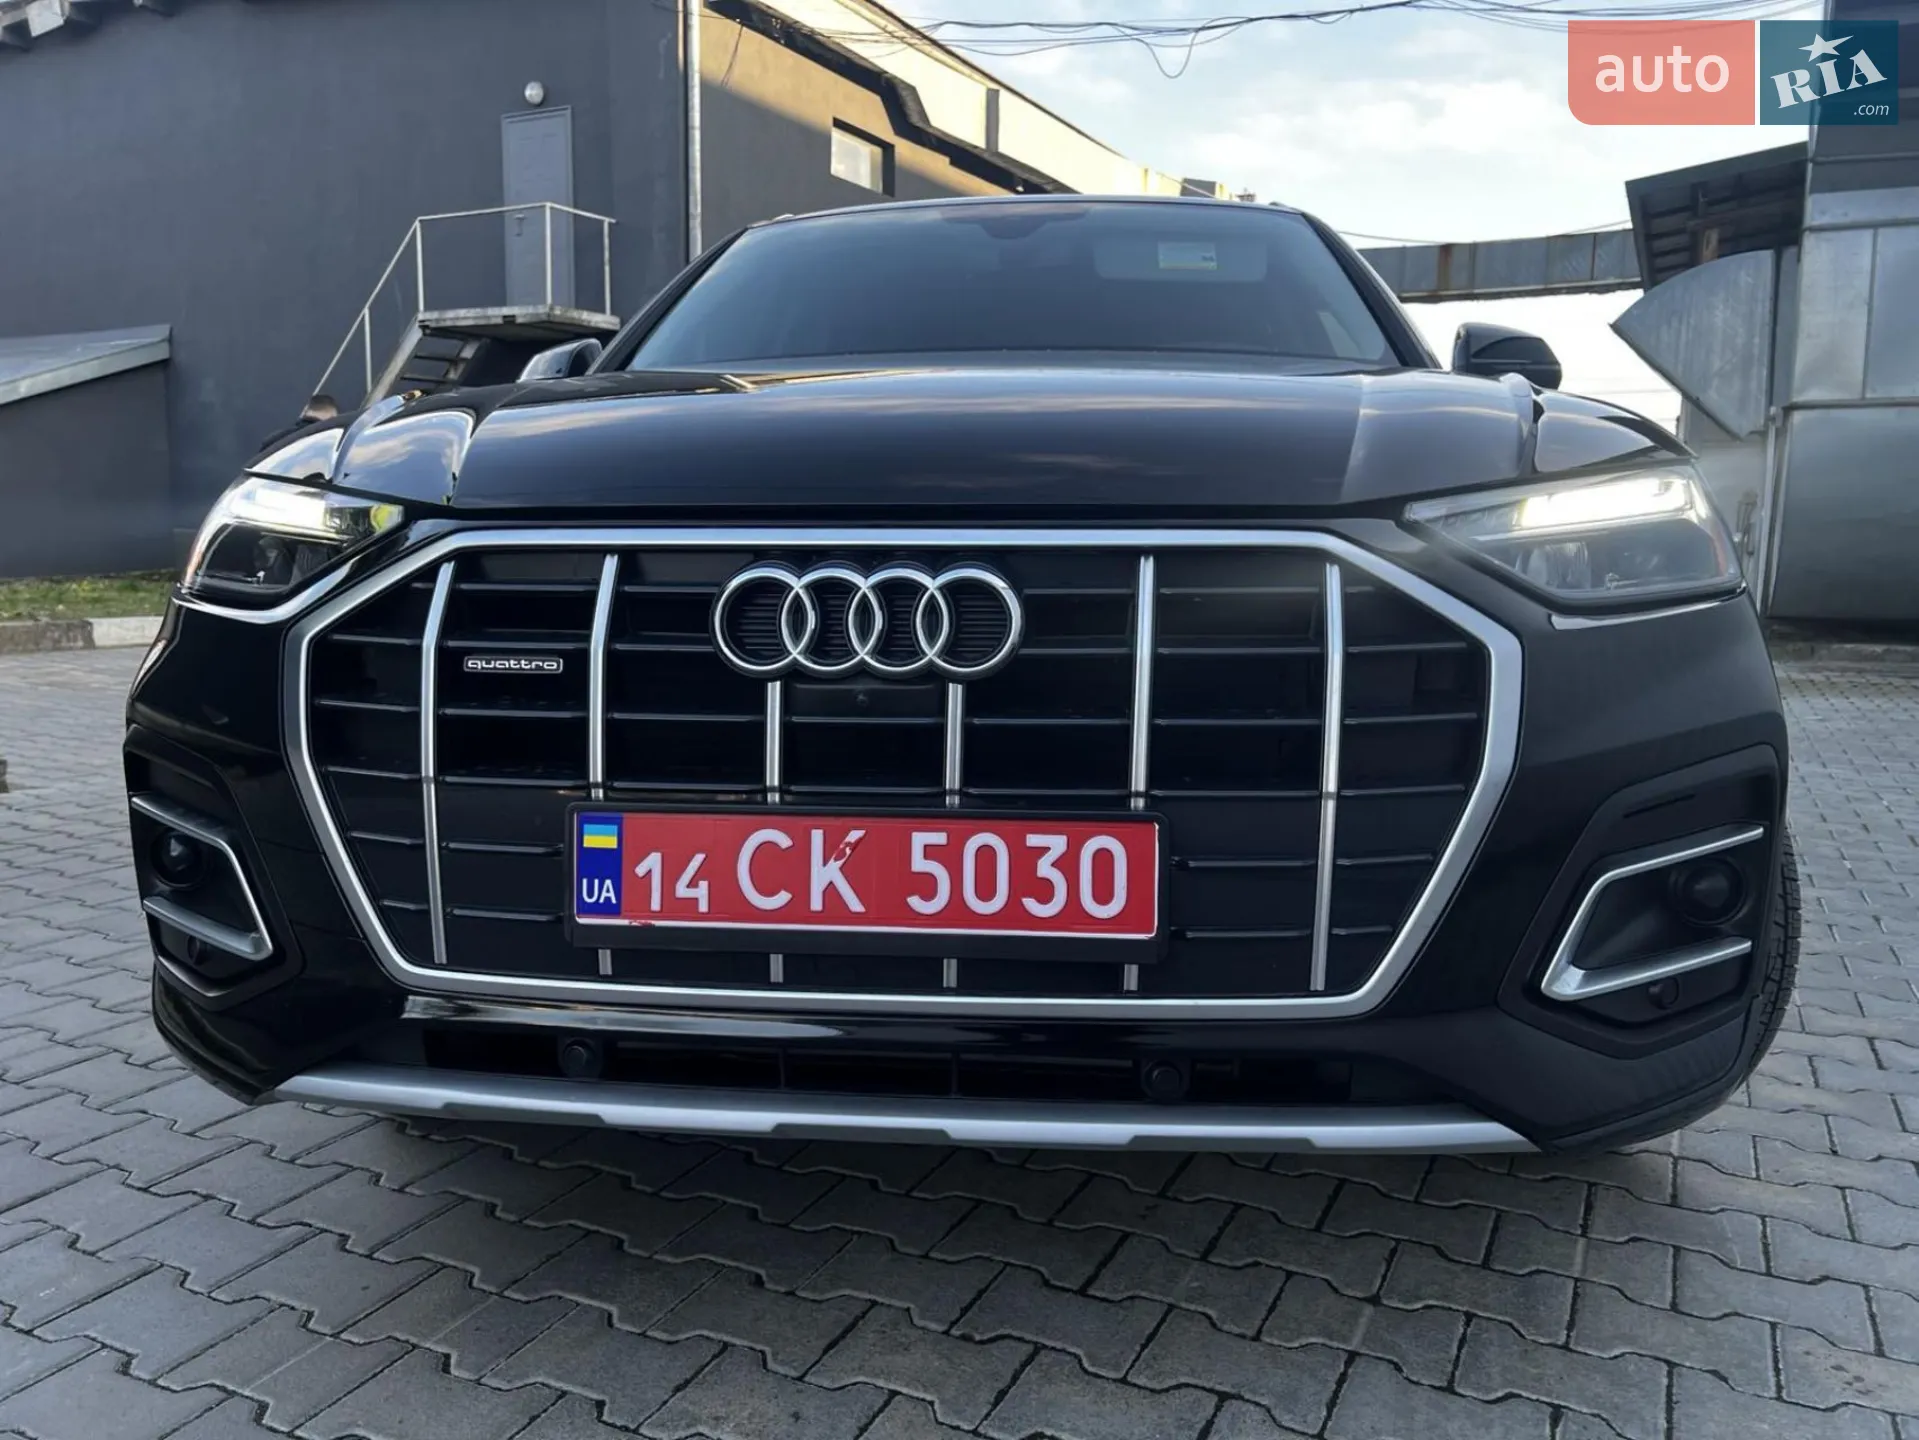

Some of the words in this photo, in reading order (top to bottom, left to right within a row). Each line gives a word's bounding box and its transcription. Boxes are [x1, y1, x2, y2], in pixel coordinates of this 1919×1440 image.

[467, 659, 558, 669] quattro
[634, 851, 709, 913] 14
[737, 828, 867, 914] CK
[906, 831, 1128, 919] 5030
[582, 878, 617, 904] UA
